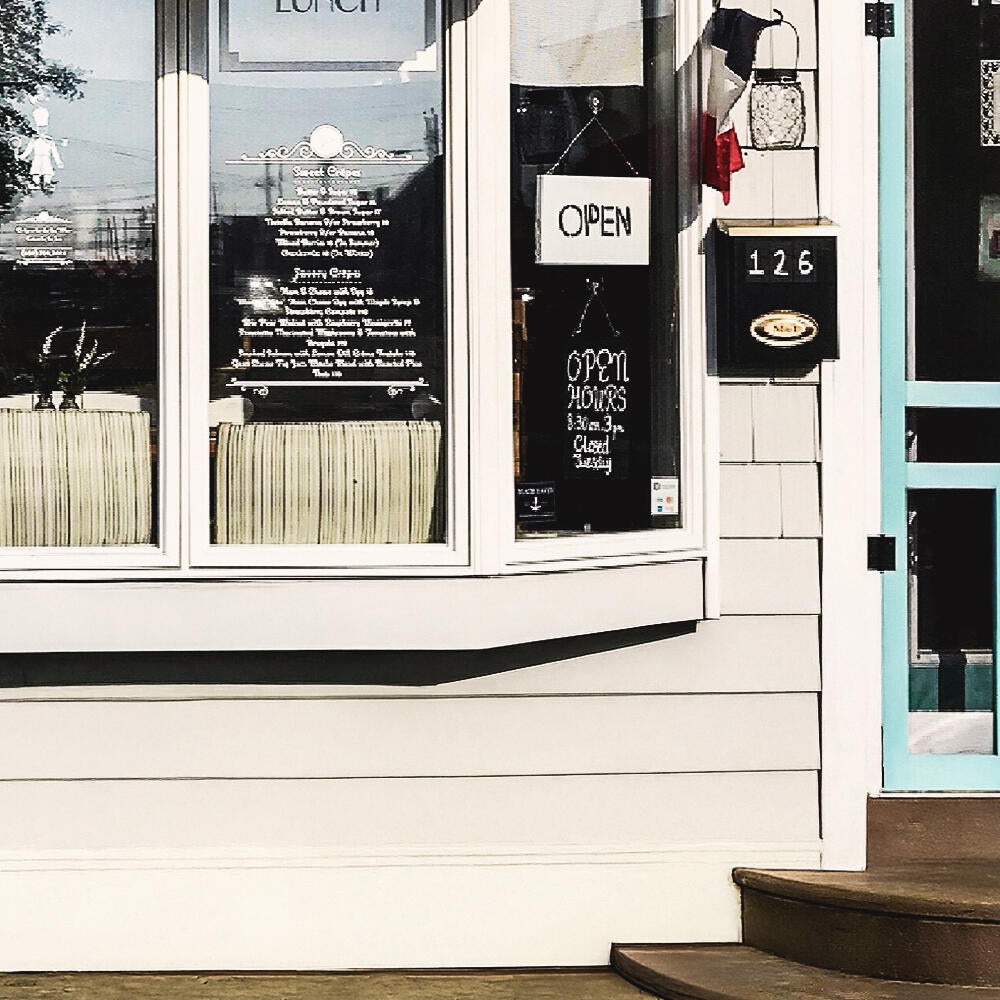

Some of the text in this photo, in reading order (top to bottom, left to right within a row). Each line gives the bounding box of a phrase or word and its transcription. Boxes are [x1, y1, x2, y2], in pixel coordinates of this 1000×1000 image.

[558, 204, 632, 238] OPEN
[749, 249, 815, 276] 126
[567, 348, 630, 382] OPEN
